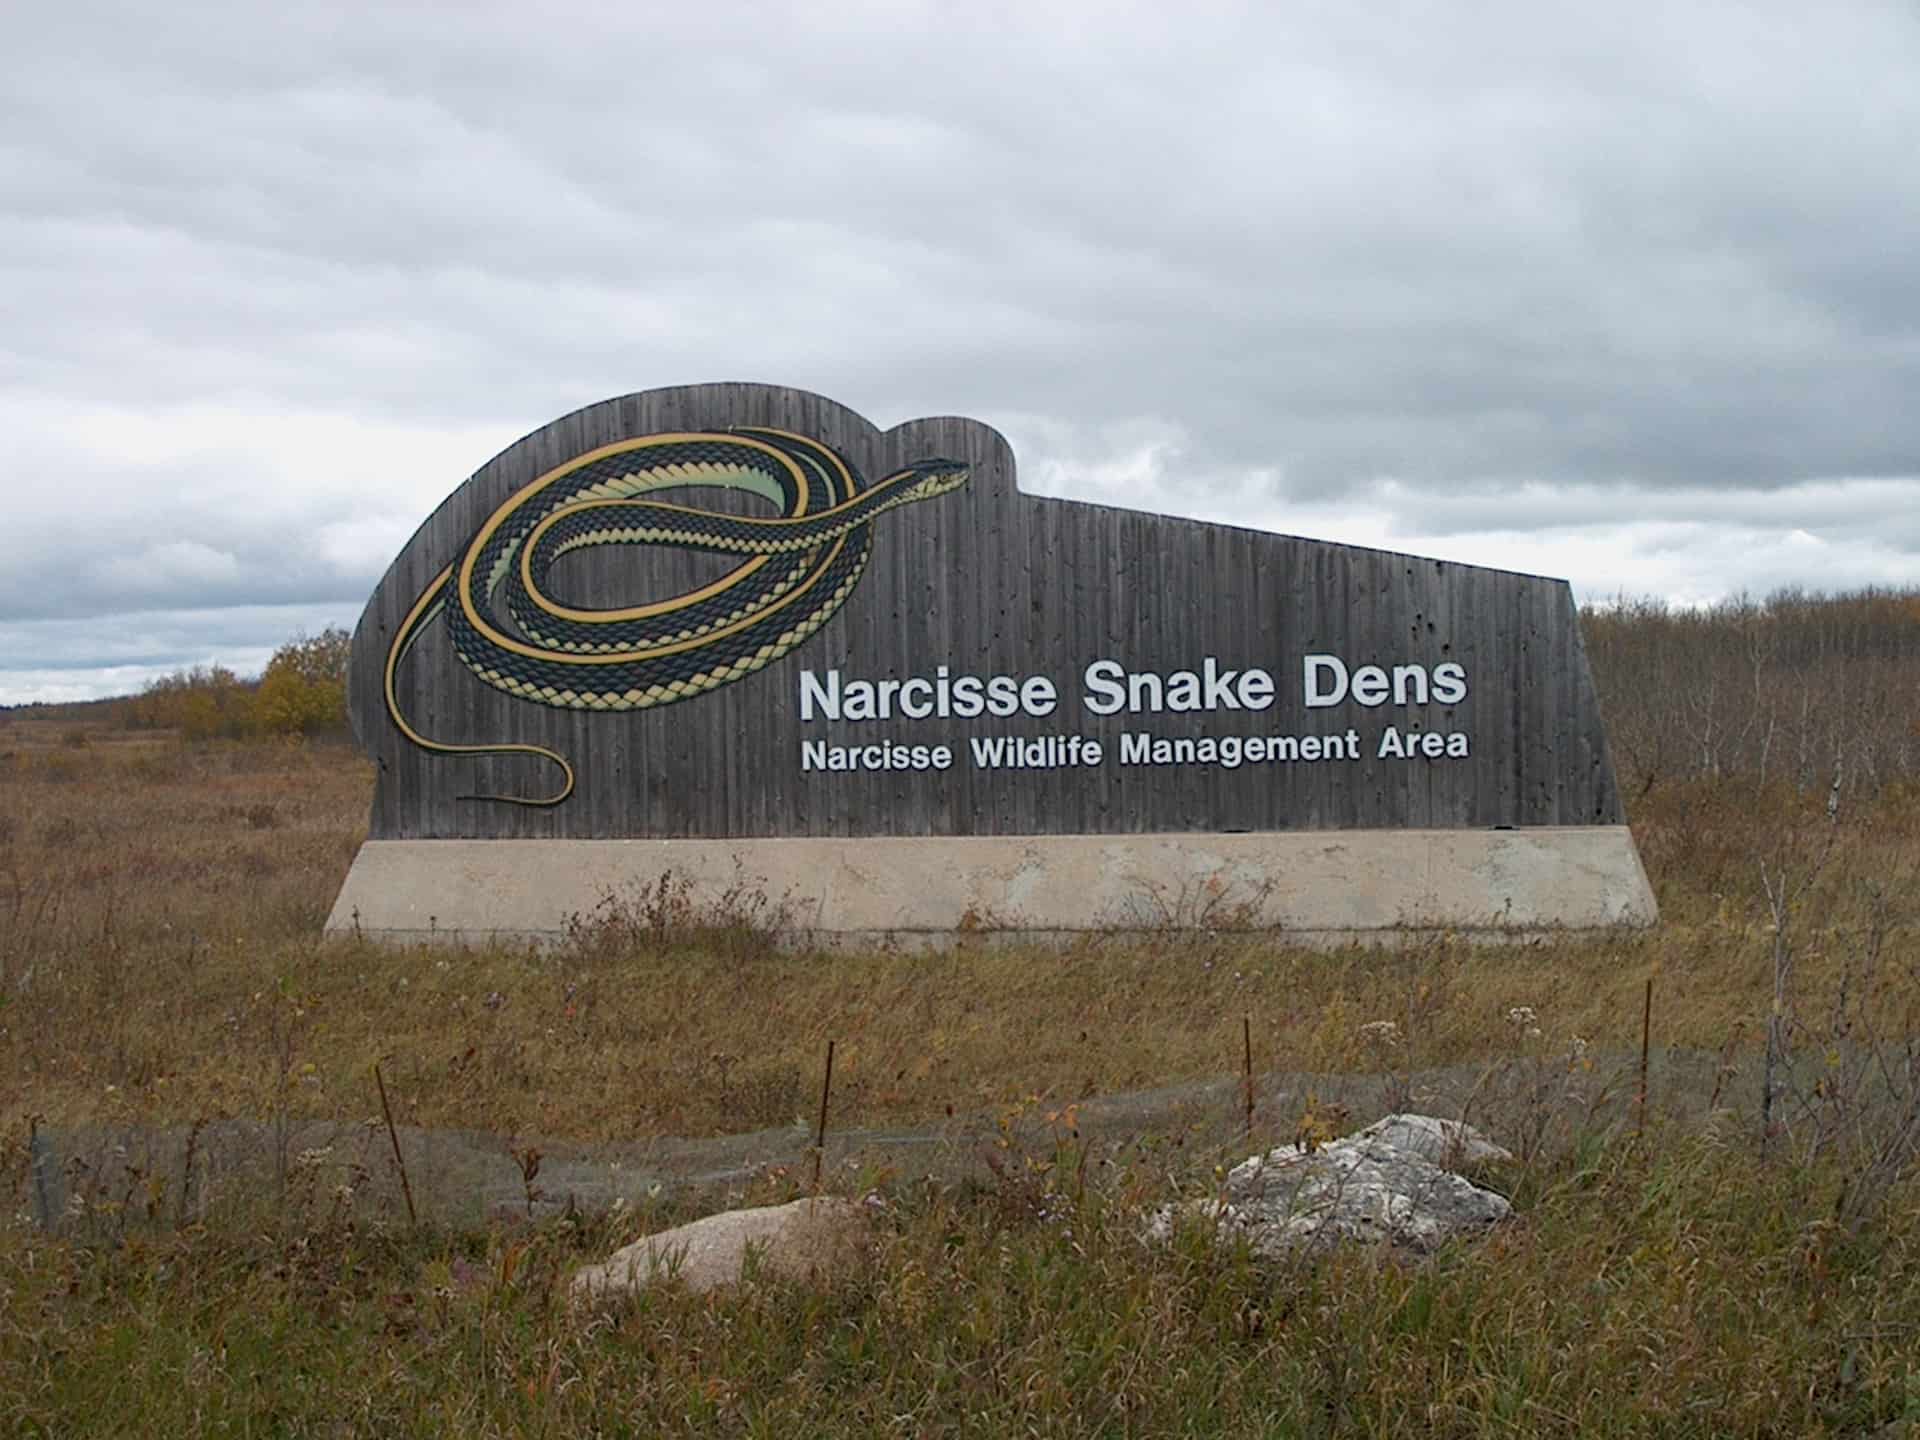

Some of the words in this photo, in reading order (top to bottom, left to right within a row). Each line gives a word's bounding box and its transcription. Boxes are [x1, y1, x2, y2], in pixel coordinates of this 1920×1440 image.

[800, 666, 1057, 720] Narcisse
[1083, 658, 1275, 714] Snake
[1304, 655, 1467, 707] Dens
[802, 739, 952, 770] Narcisse
[970, 736, 1102, 767] Wildlife
[1121, 730, 1360, 767] Management
[1378, 727, 1468, 758] Area
